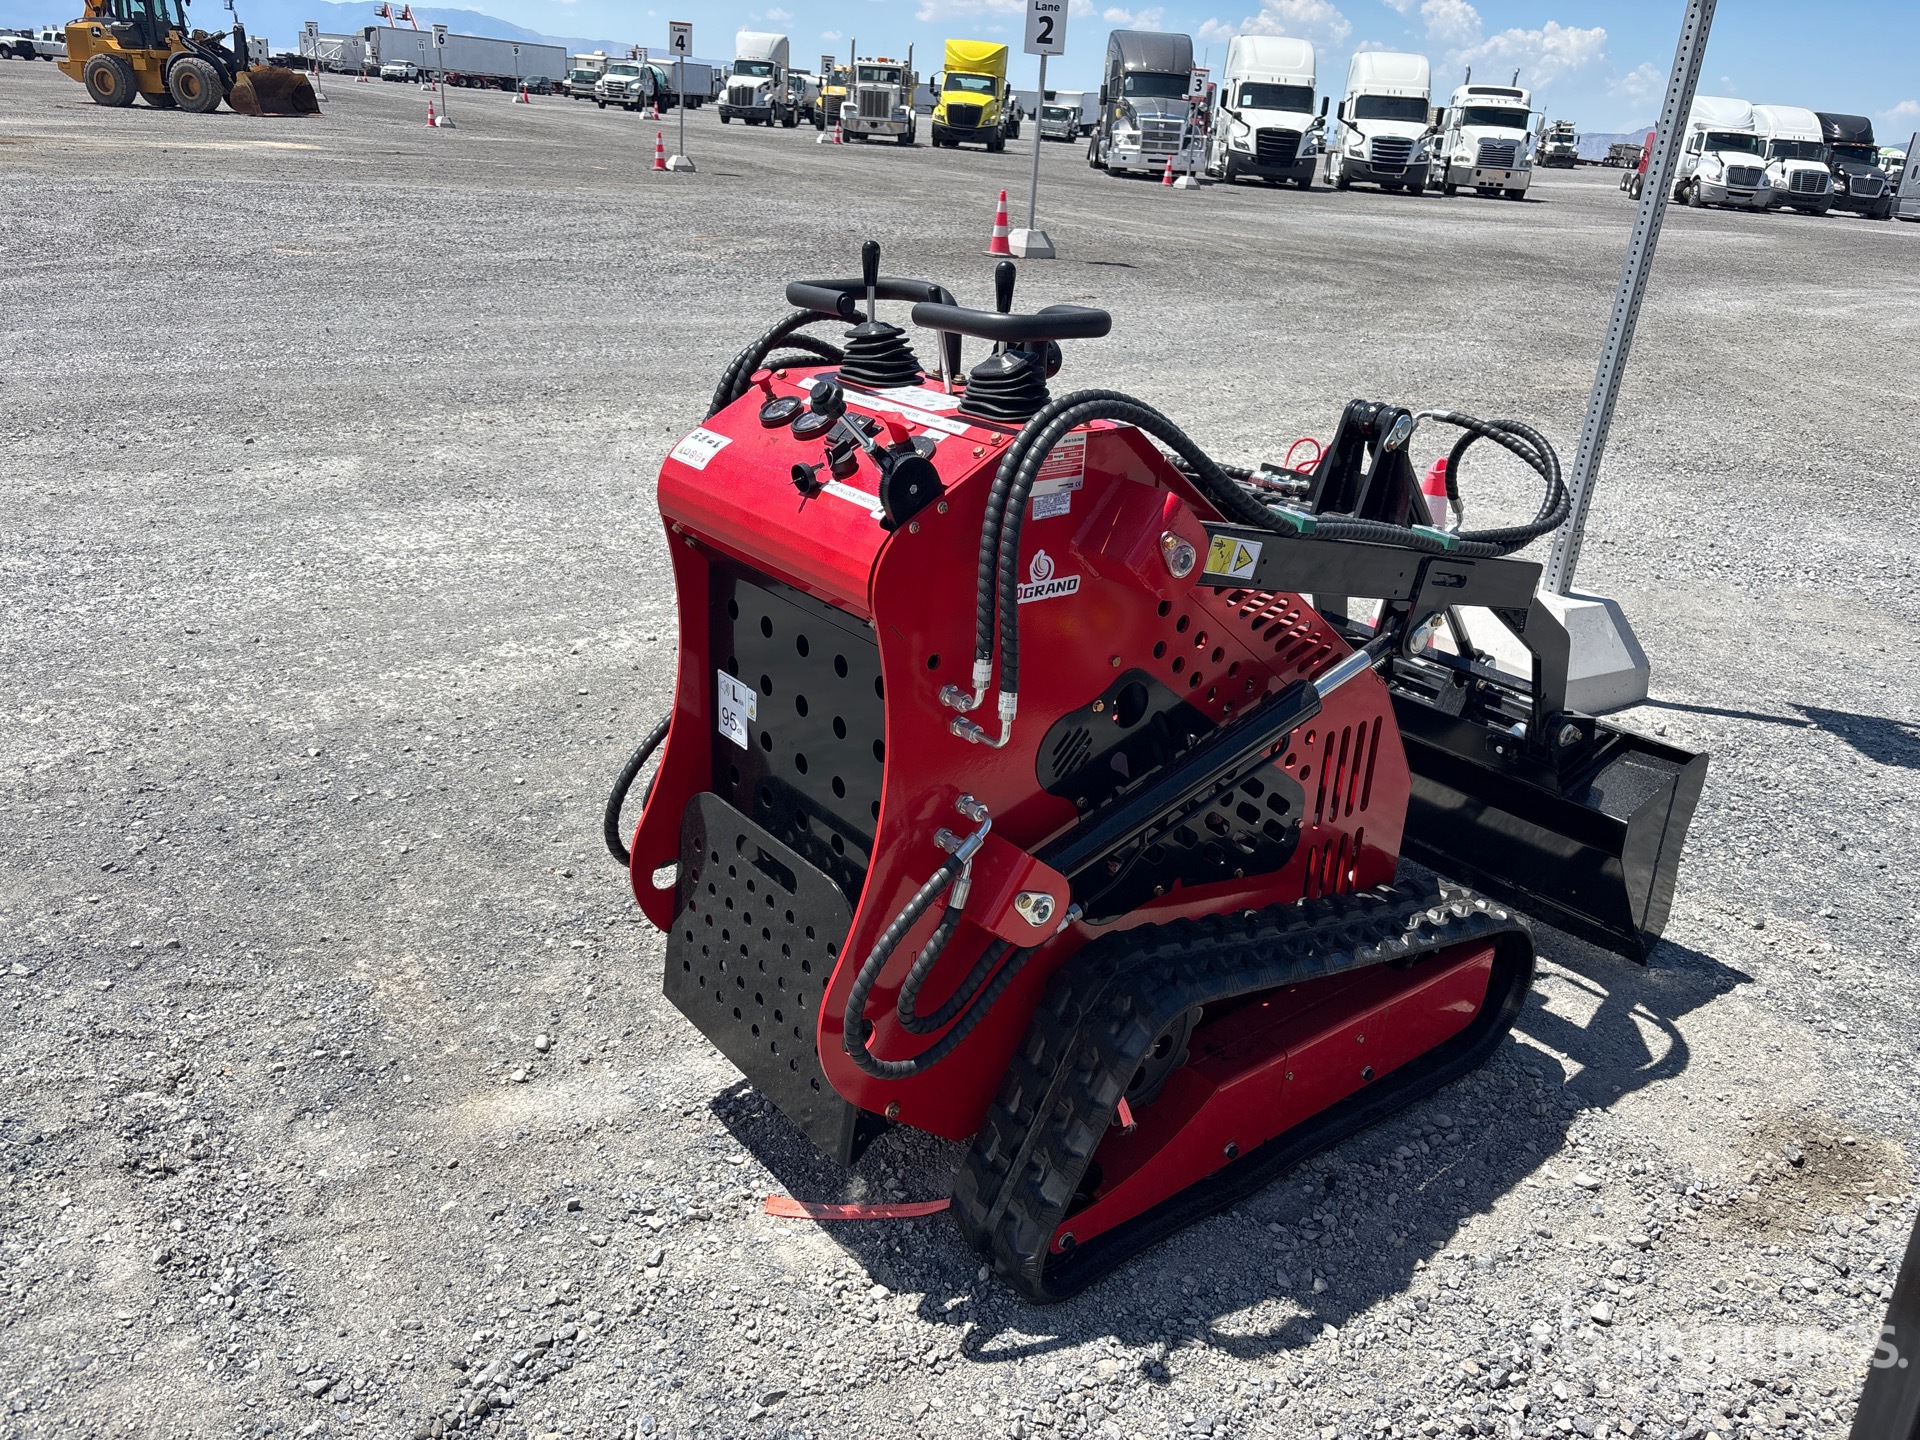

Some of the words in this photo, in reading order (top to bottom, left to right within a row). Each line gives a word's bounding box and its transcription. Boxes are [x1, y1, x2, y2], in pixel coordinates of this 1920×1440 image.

[1035, 1, 1060, 12] Lane
[308, 28, 314, 37] 8
[1036, 15, 1054, 45] 2
[438, 33, 445, 45] 6
[675, 34, 686, 51] 4
[513, 47, 519, 55] 9
[824, 63, 831, 73] 5
[1194, 78, 1202, 92] 3
[722, 706, 737, 731] 95
